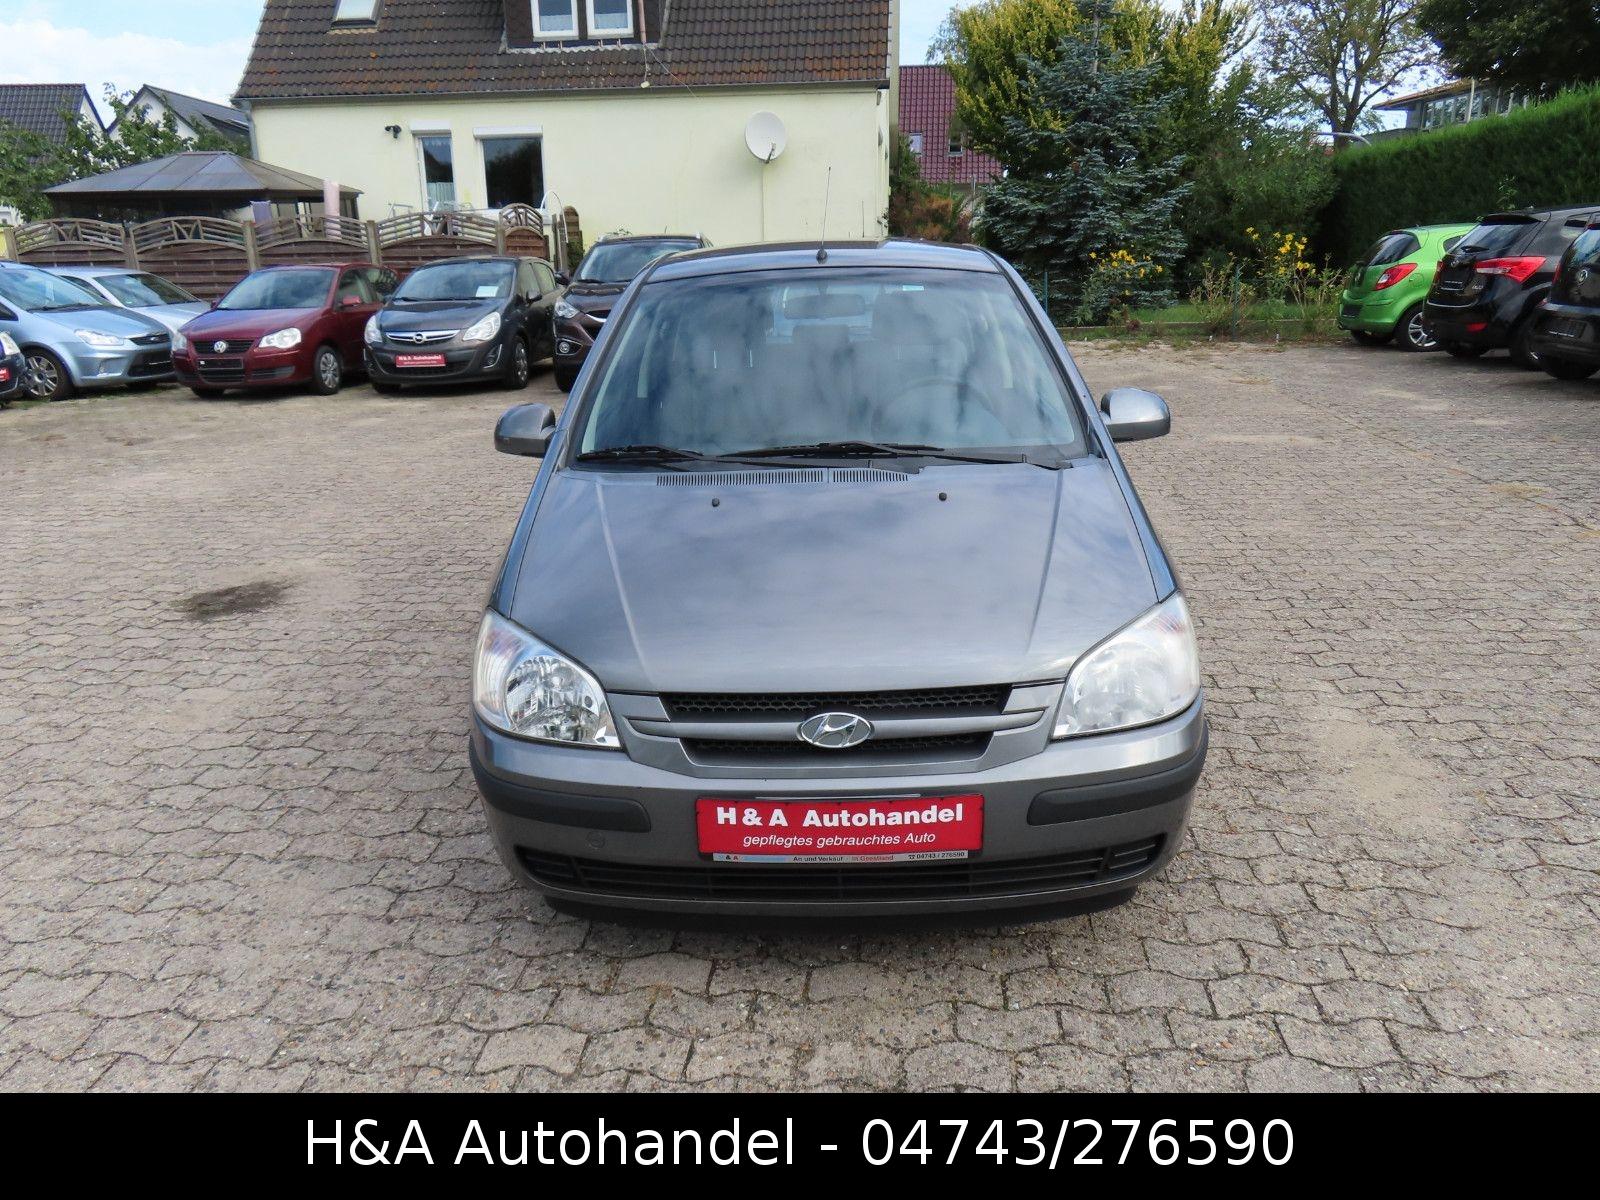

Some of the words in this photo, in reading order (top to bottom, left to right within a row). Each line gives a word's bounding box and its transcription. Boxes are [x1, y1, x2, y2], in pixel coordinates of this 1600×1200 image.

[716, 806, 737, 825] H
[742, 807, 764, 826] &
[768, 808, 789, 827] A
[802, 803, 964, 828] Autohandel
[742, 833, 813, 848] gepflegtes
[816, 833, 901, 848] gebrauchtes
[903, 832, 937, 844] Auto
